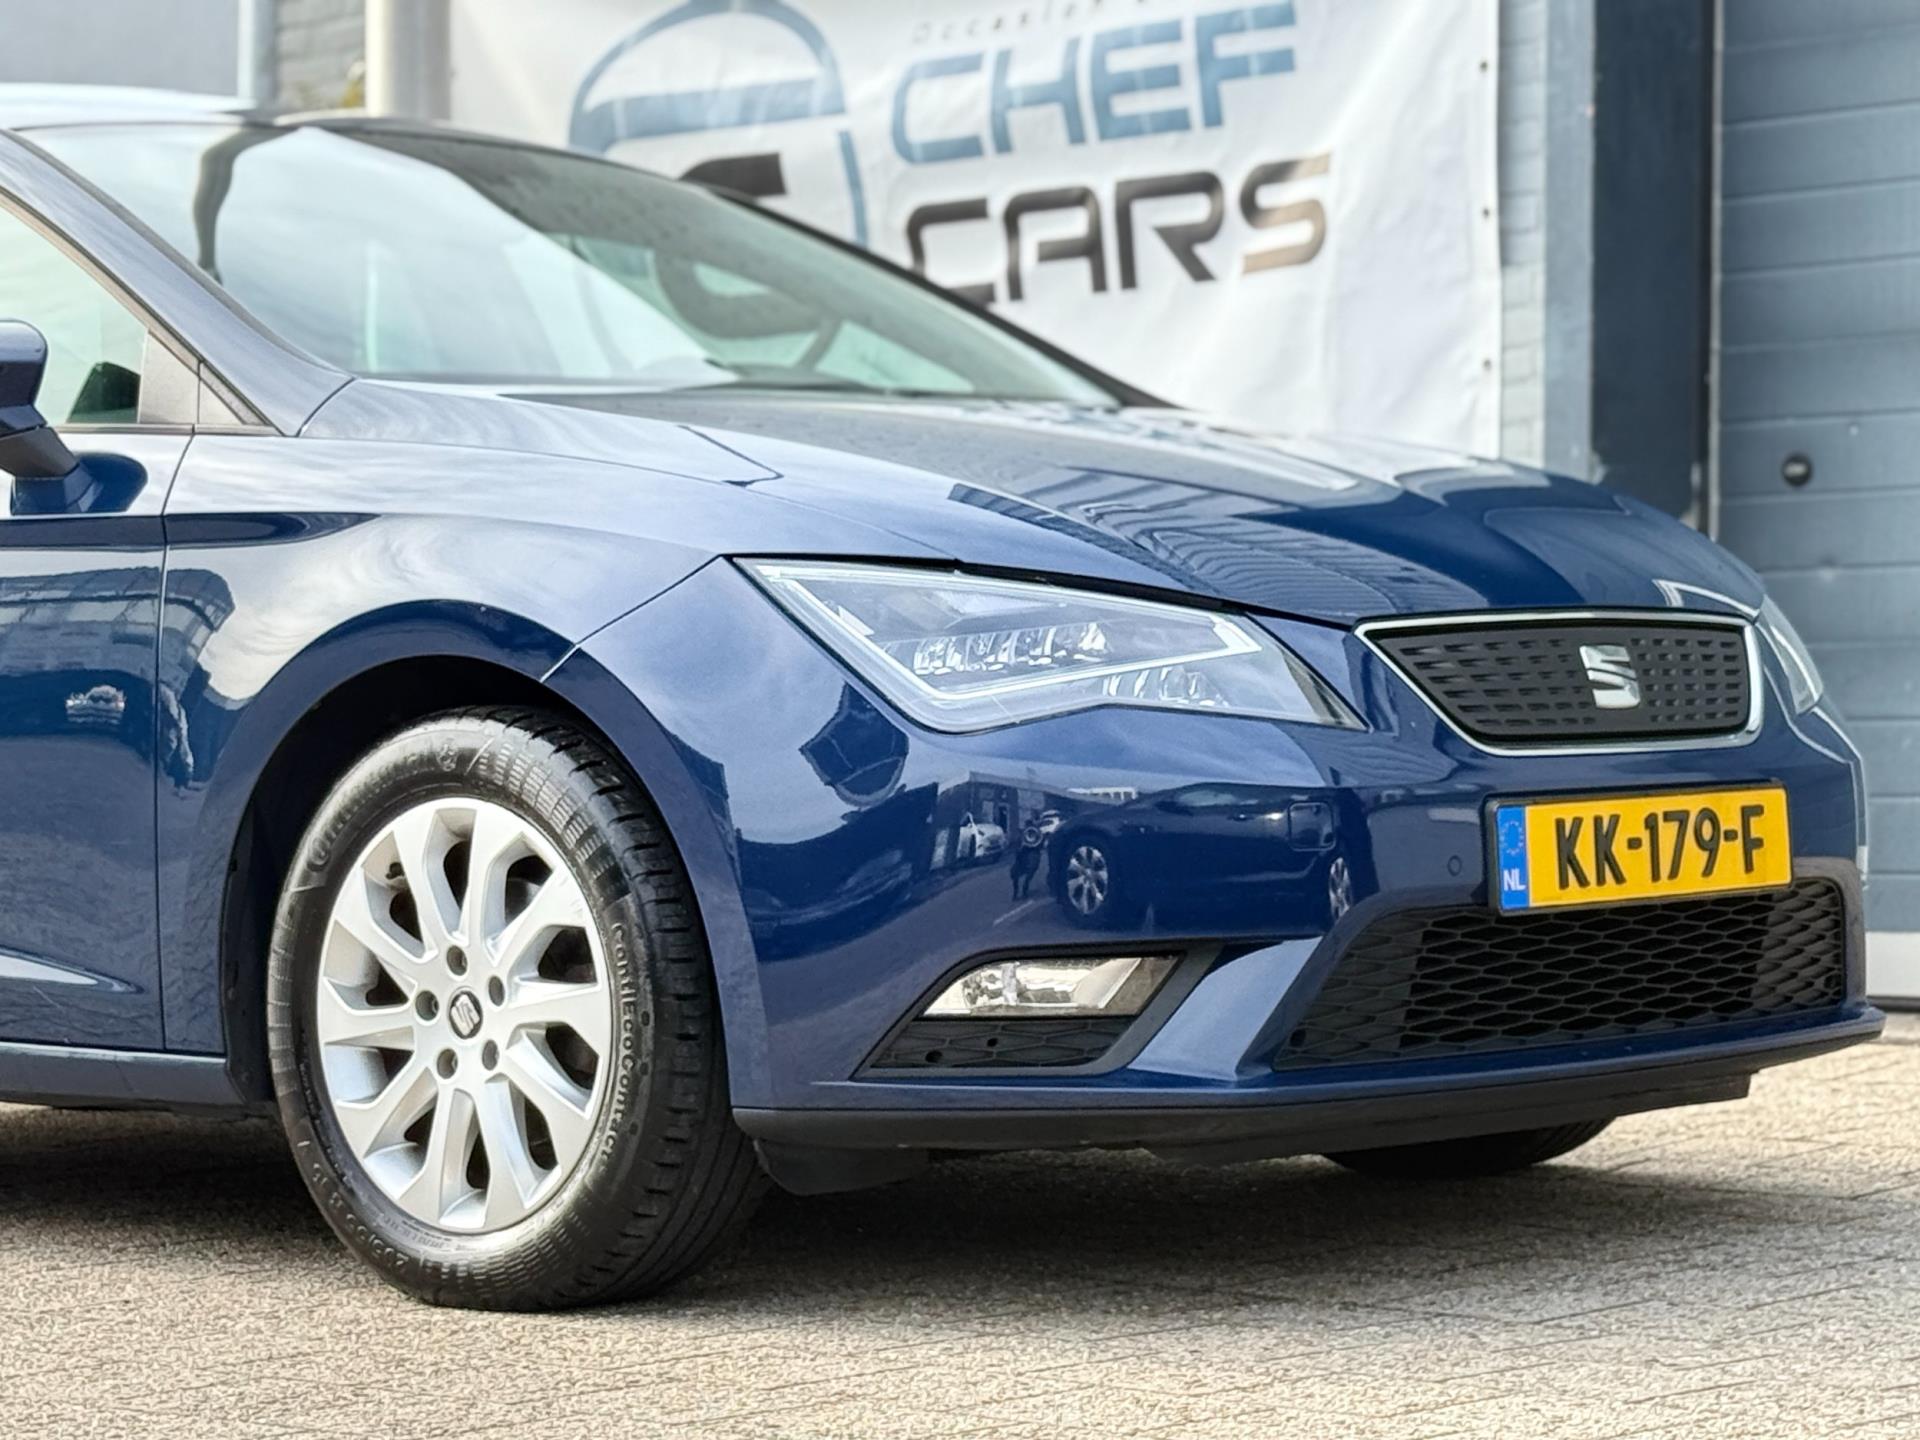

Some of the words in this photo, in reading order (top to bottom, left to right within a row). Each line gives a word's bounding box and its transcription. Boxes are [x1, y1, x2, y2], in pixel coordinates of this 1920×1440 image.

[892, 0, 1296, 164] CHEF
[906, 152, 1331, 303] CARS
[1503, 868, 1526, 892] NL
[1555, 804, 1764, 890] KK-179-F
